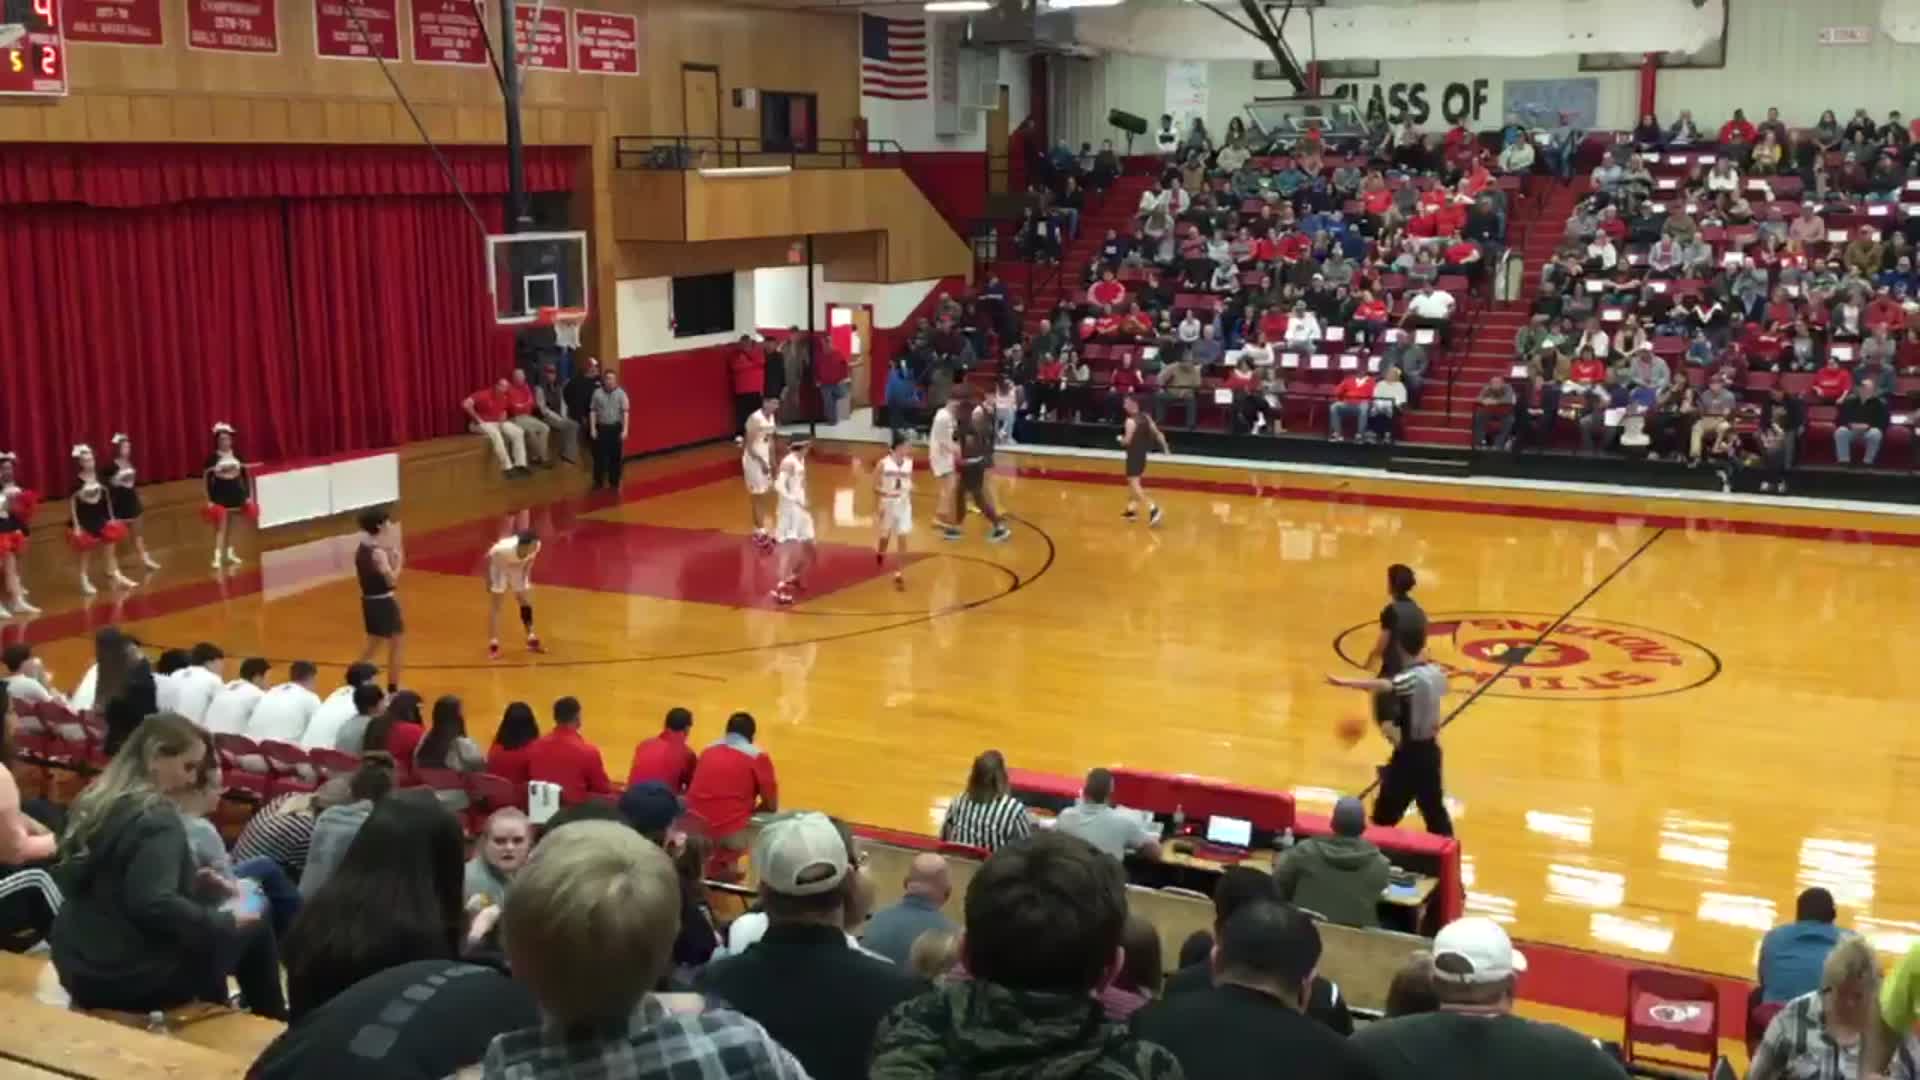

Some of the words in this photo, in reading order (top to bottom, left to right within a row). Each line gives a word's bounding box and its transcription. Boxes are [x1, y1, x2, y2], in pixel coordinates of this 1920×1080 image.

[41, 46, 56, 74] 2
[1333, 83, 1430, 125] CLASS
[1442, 79, 1489, 125] OF
